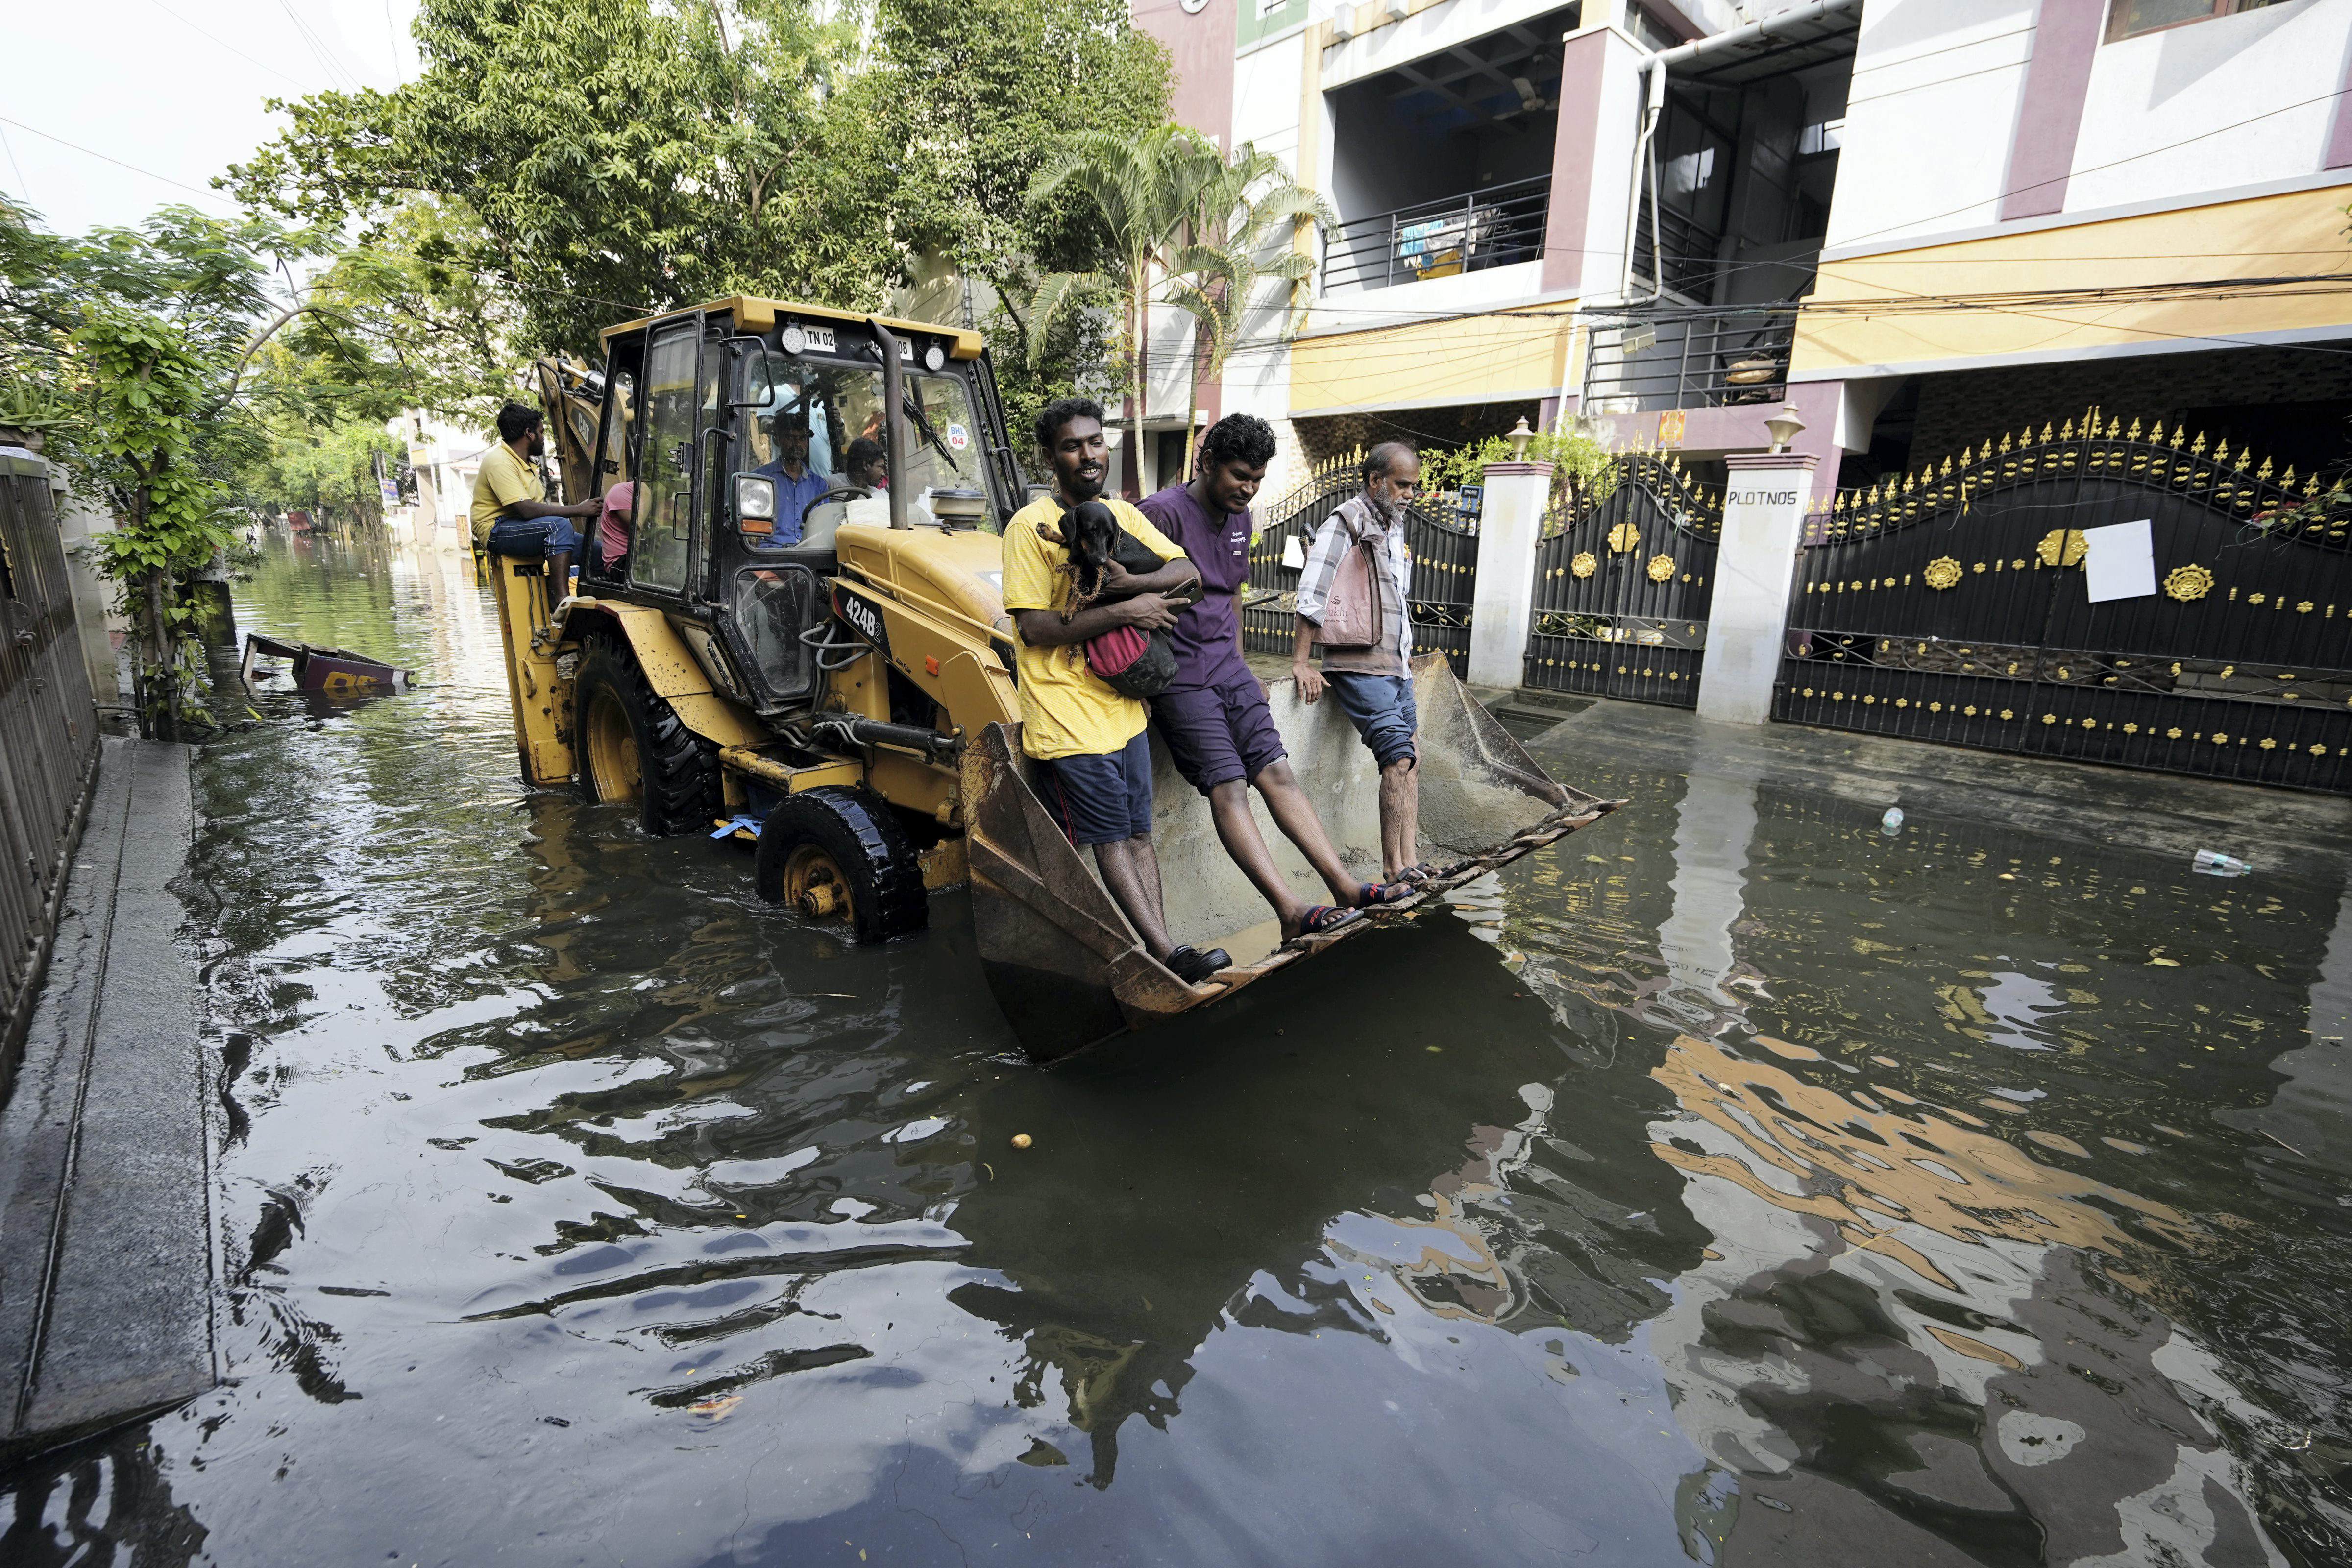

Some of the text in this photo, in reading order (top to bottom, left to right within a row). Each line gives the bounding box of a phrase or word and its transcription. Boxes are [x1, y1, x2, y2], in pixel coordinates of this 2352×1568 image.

[807, 330, 834, 346] TN 02
[579, 412, 589, 444] CAT
[951, 426, 964, 435] BHL
[952, 436, 964, 445] 04
[1326, 607, 1348, 617] ukhi
